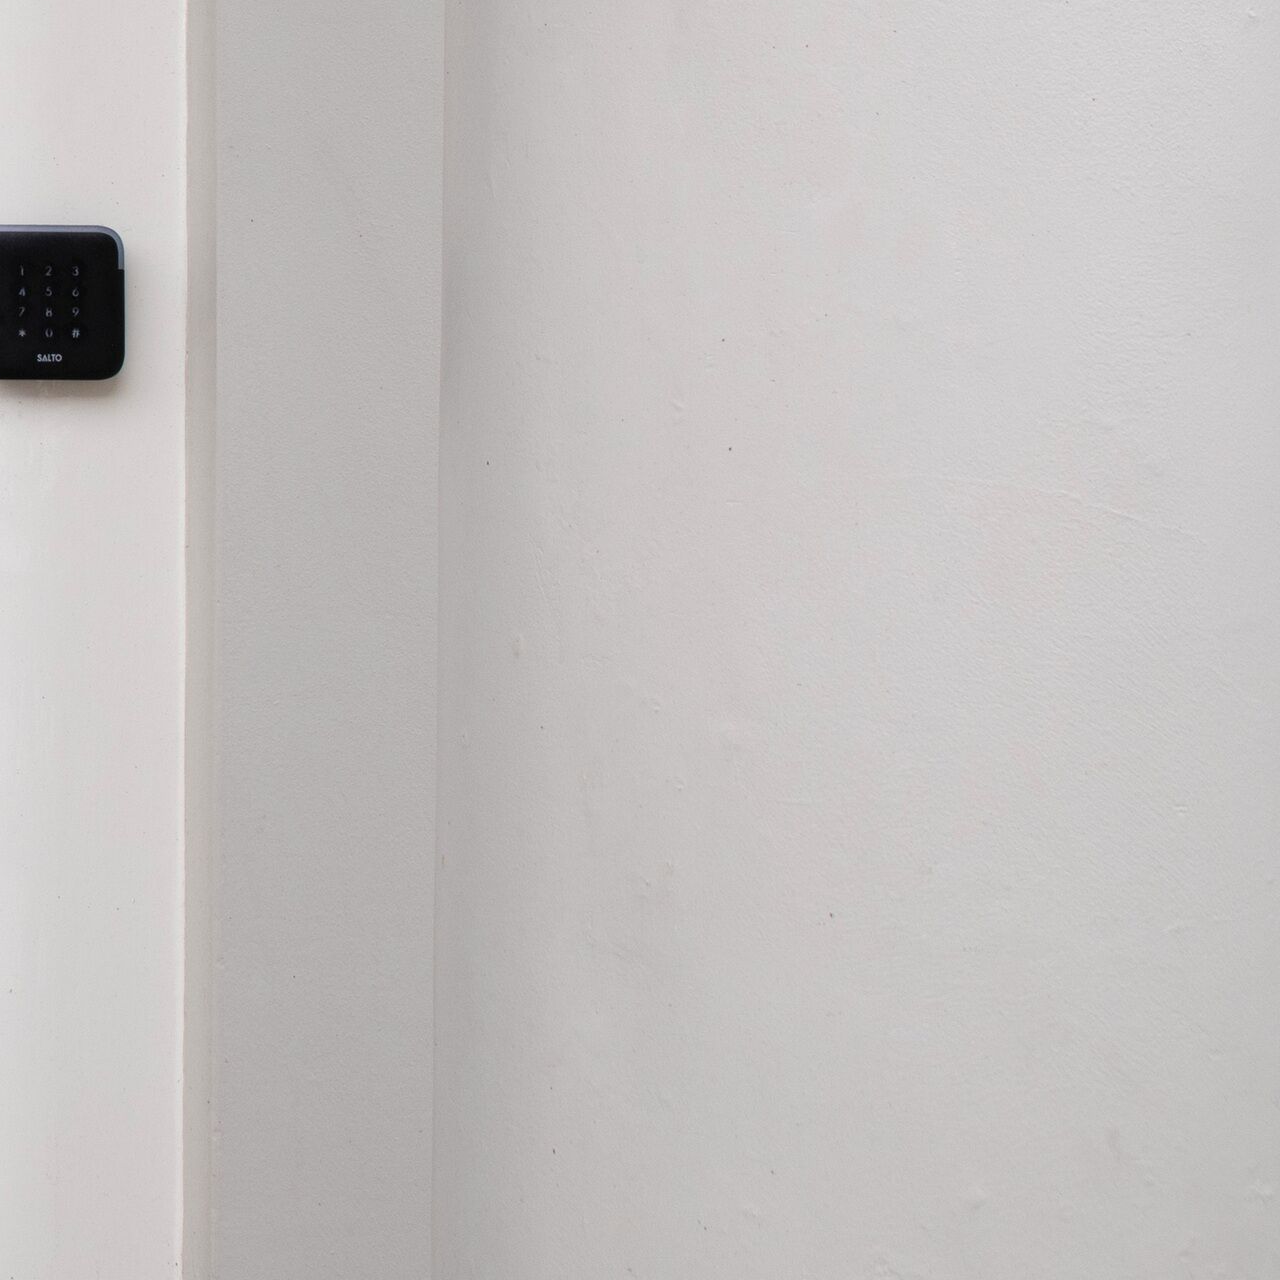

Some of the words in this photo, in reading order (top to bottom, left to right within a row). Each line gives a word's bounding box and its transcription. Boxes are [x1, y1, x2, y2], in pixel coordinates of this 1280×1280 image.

[45, 266, 52, 277] 2
[72, 265, 80, 277] 3
[18, 287, 26, 297] 4
[45, 287, 53, 297] 5
[72, 287, 80, 297] 6
[18, 307, 26, 317] 7
[45, 307, 53, 318] 8
[72, 307, 80, 317] 9
[45, 328, 53, 338] 0
[36, 353, 63, 363] SALTO
